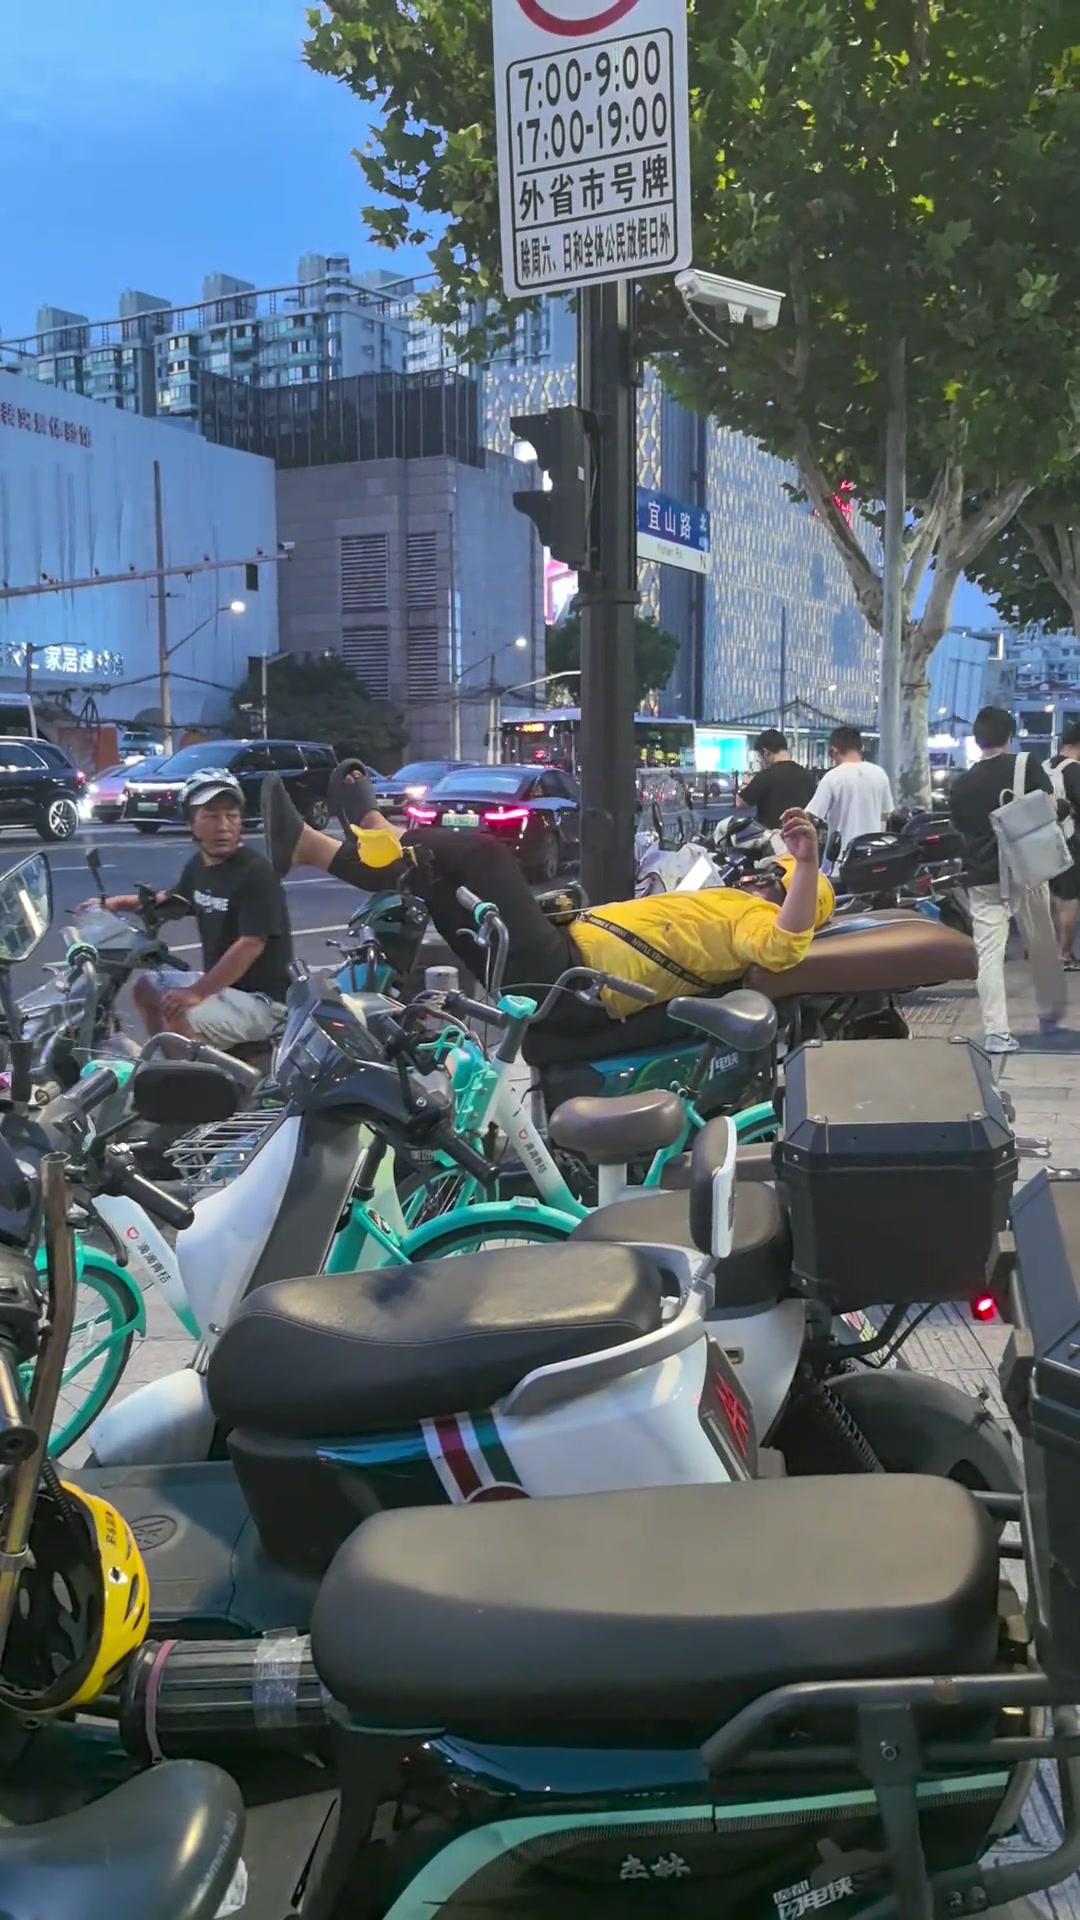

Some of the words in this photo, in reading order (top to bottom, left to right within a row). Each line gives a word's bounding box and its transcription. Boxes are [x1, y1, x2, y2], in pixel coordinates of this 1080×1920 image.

[518, 41, 661, 112] 7:00-9:00
[516, 92, 667, 165] 17:00-19:00
[520, 154, 669, 221] 外省市号牌
[520, 212, 671, 281] 除周六、日和全体公民放假日外
[648, 501, 692, 540] 宜山路
[700, 553, 707, 569] N
[776, 1875, 854, 1920] 闪电侠
